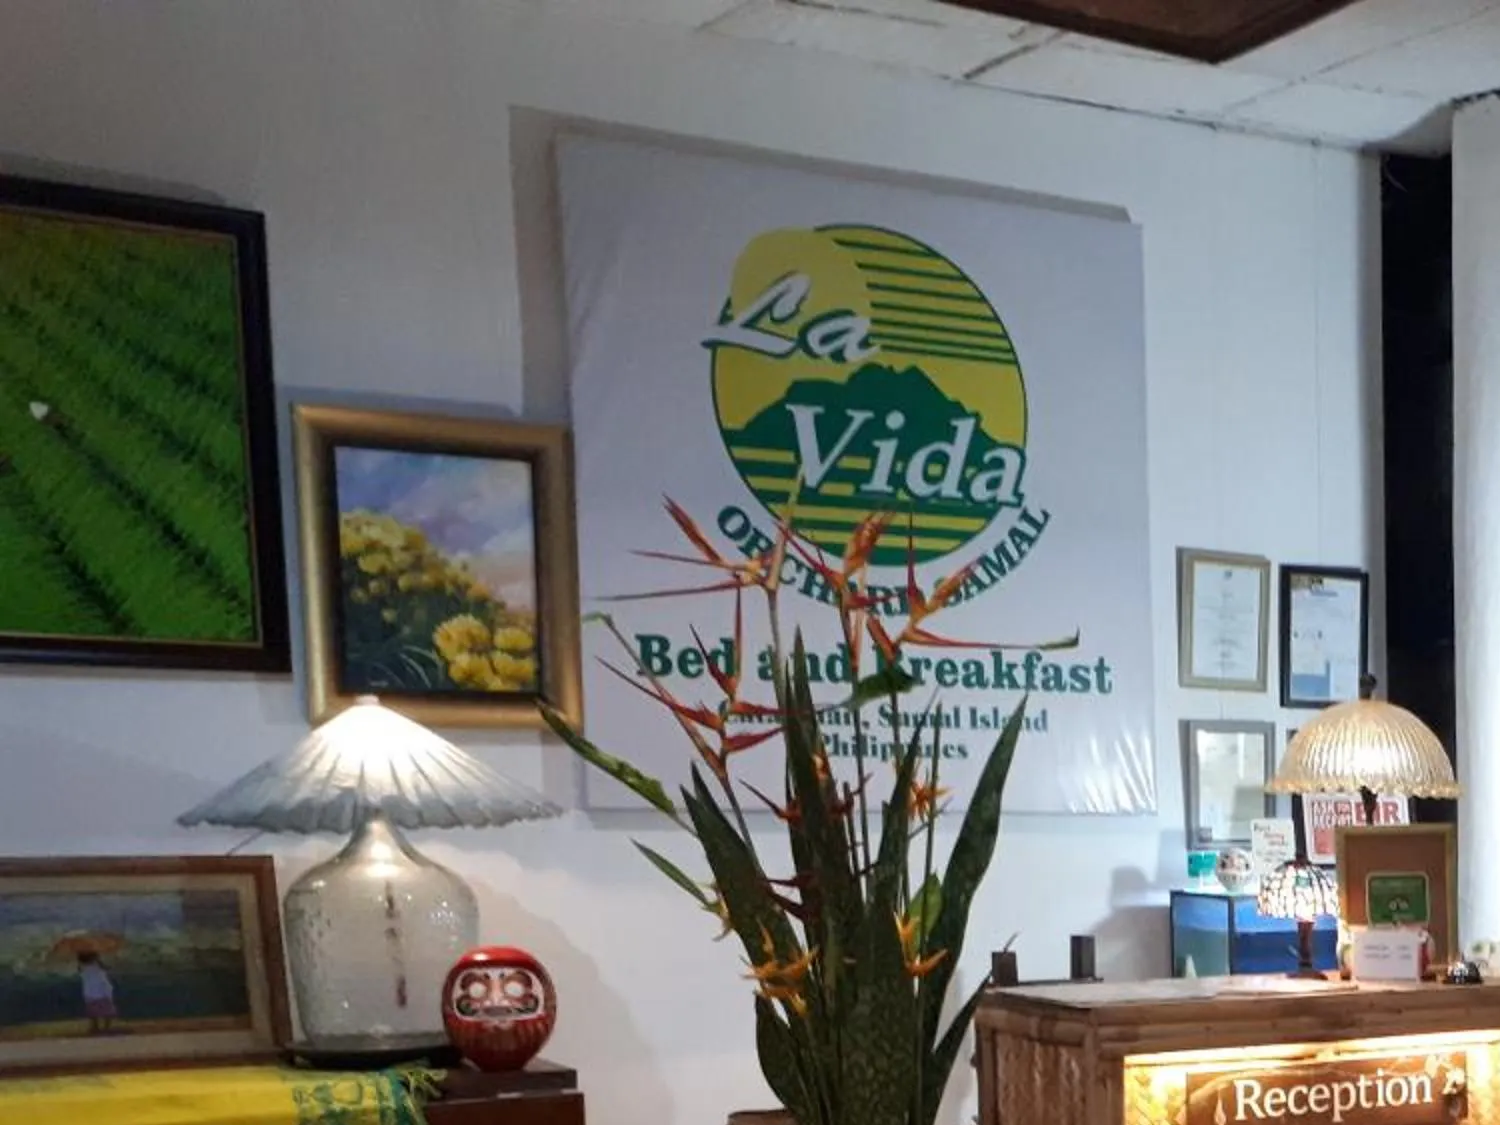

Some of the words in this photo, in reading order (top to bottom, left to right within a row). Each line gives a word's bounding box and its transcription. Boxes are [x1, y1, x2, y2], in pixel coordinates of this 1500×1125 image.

[700, 270, 881, 362] La
[785, 402, 1026, 508] Vida
[969, 706, 1048, 732] Islnd
[1233, 1068, 1433, 1124] Reception
